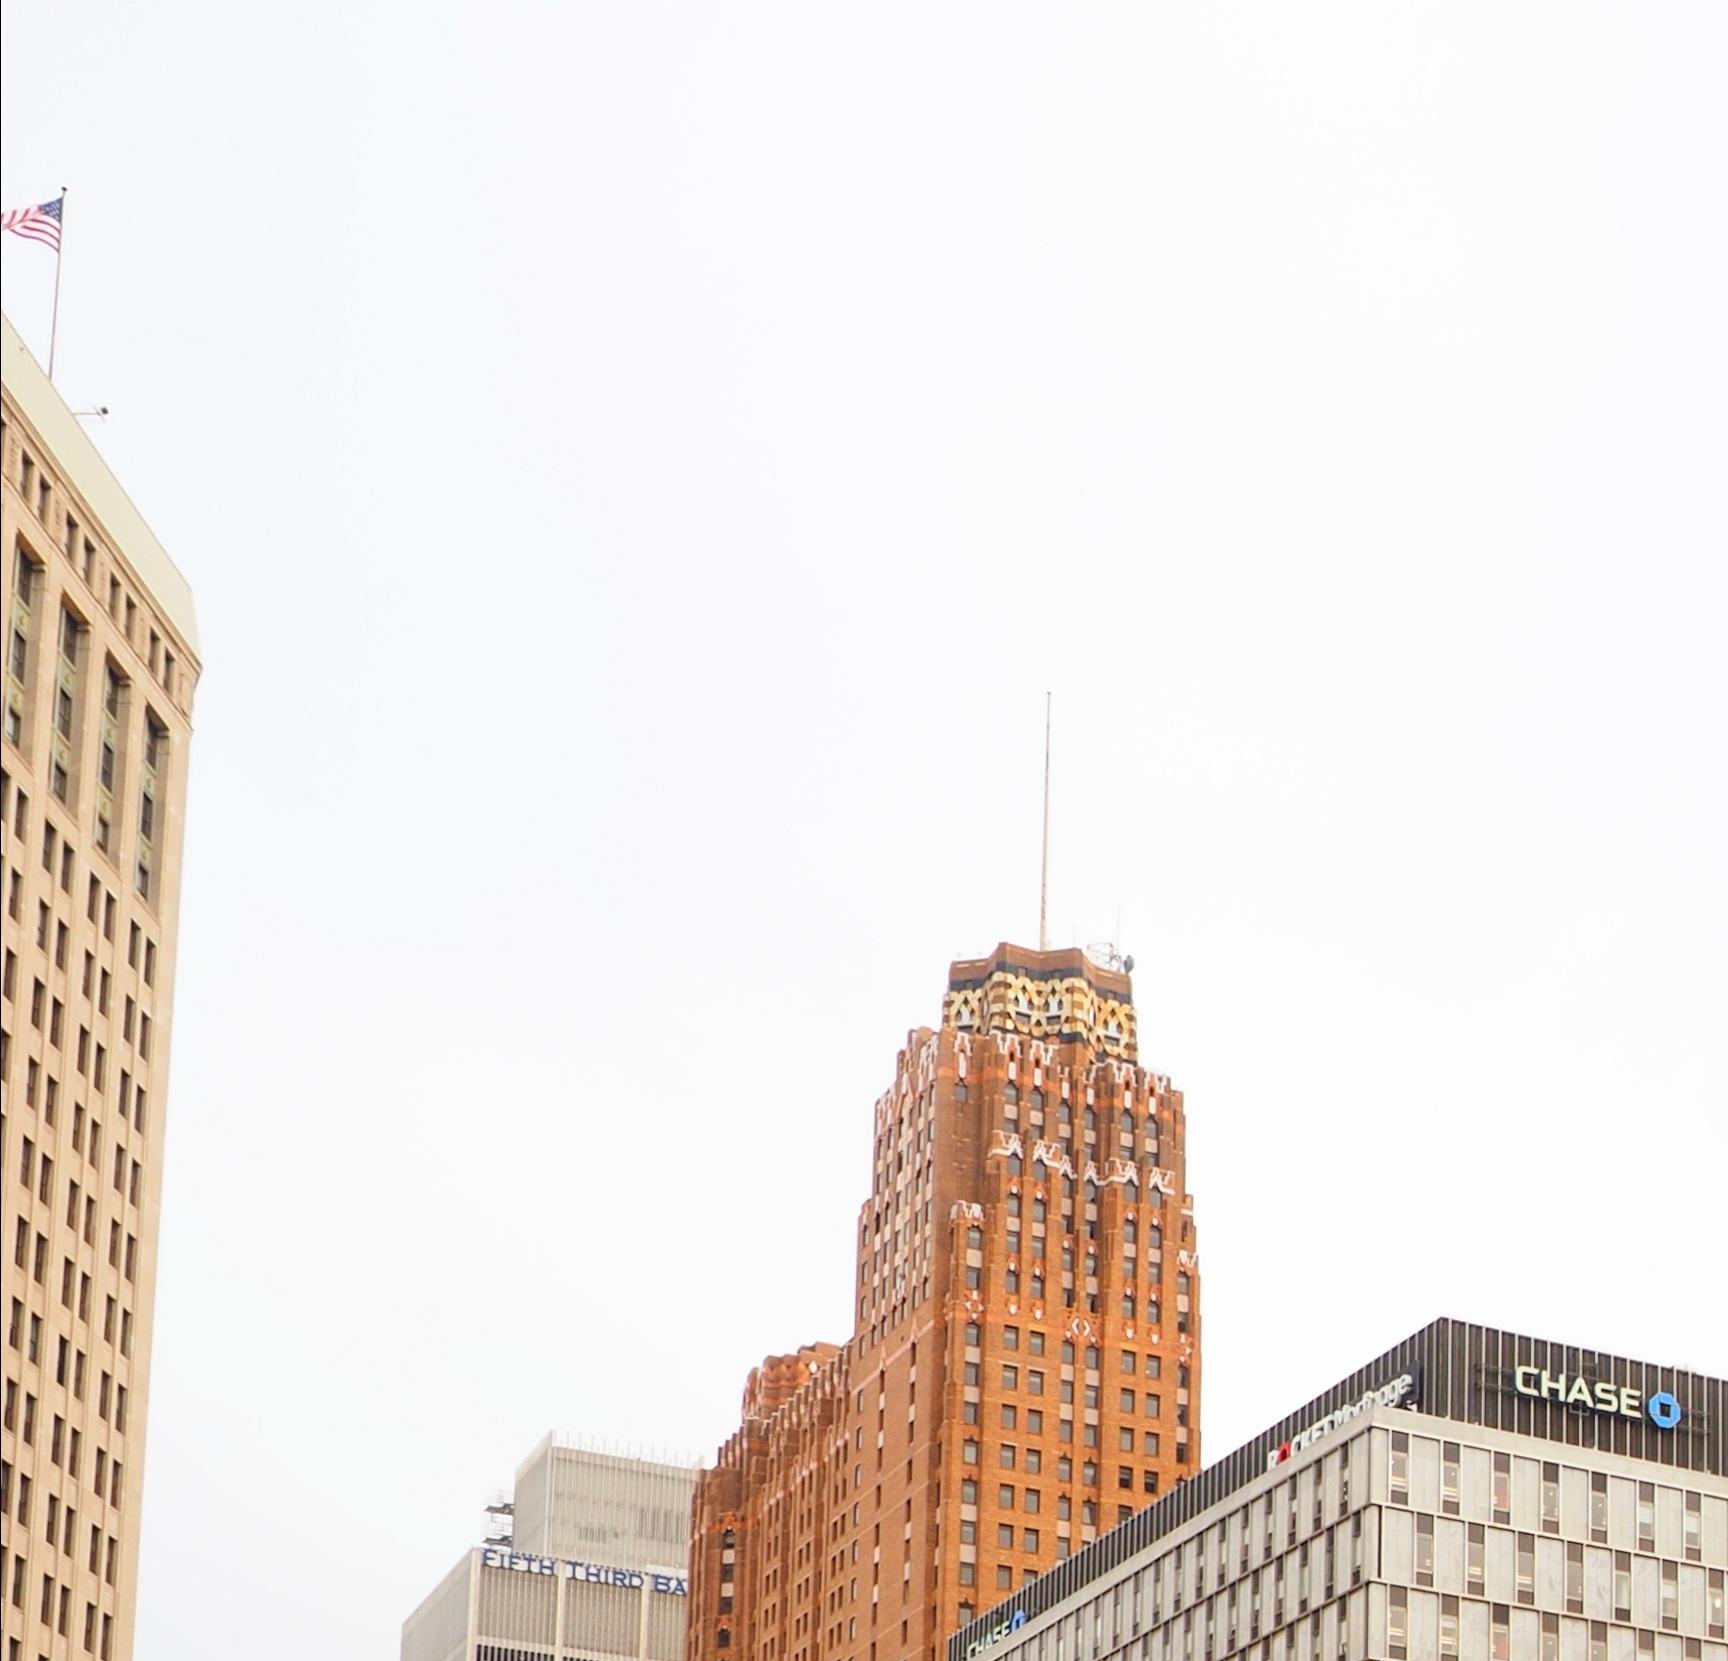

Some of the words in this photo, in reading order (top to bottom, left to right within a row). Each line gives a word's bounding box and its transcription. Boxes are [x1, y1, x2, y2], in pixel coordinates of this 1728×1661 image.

[1515, 1365, 1643, 1419] CHASE
[482, 1549, 556, 1576] FIFTH
[564, 1560, 645, 1589] THIRD
[652, 1573, 688, 1597] BA
